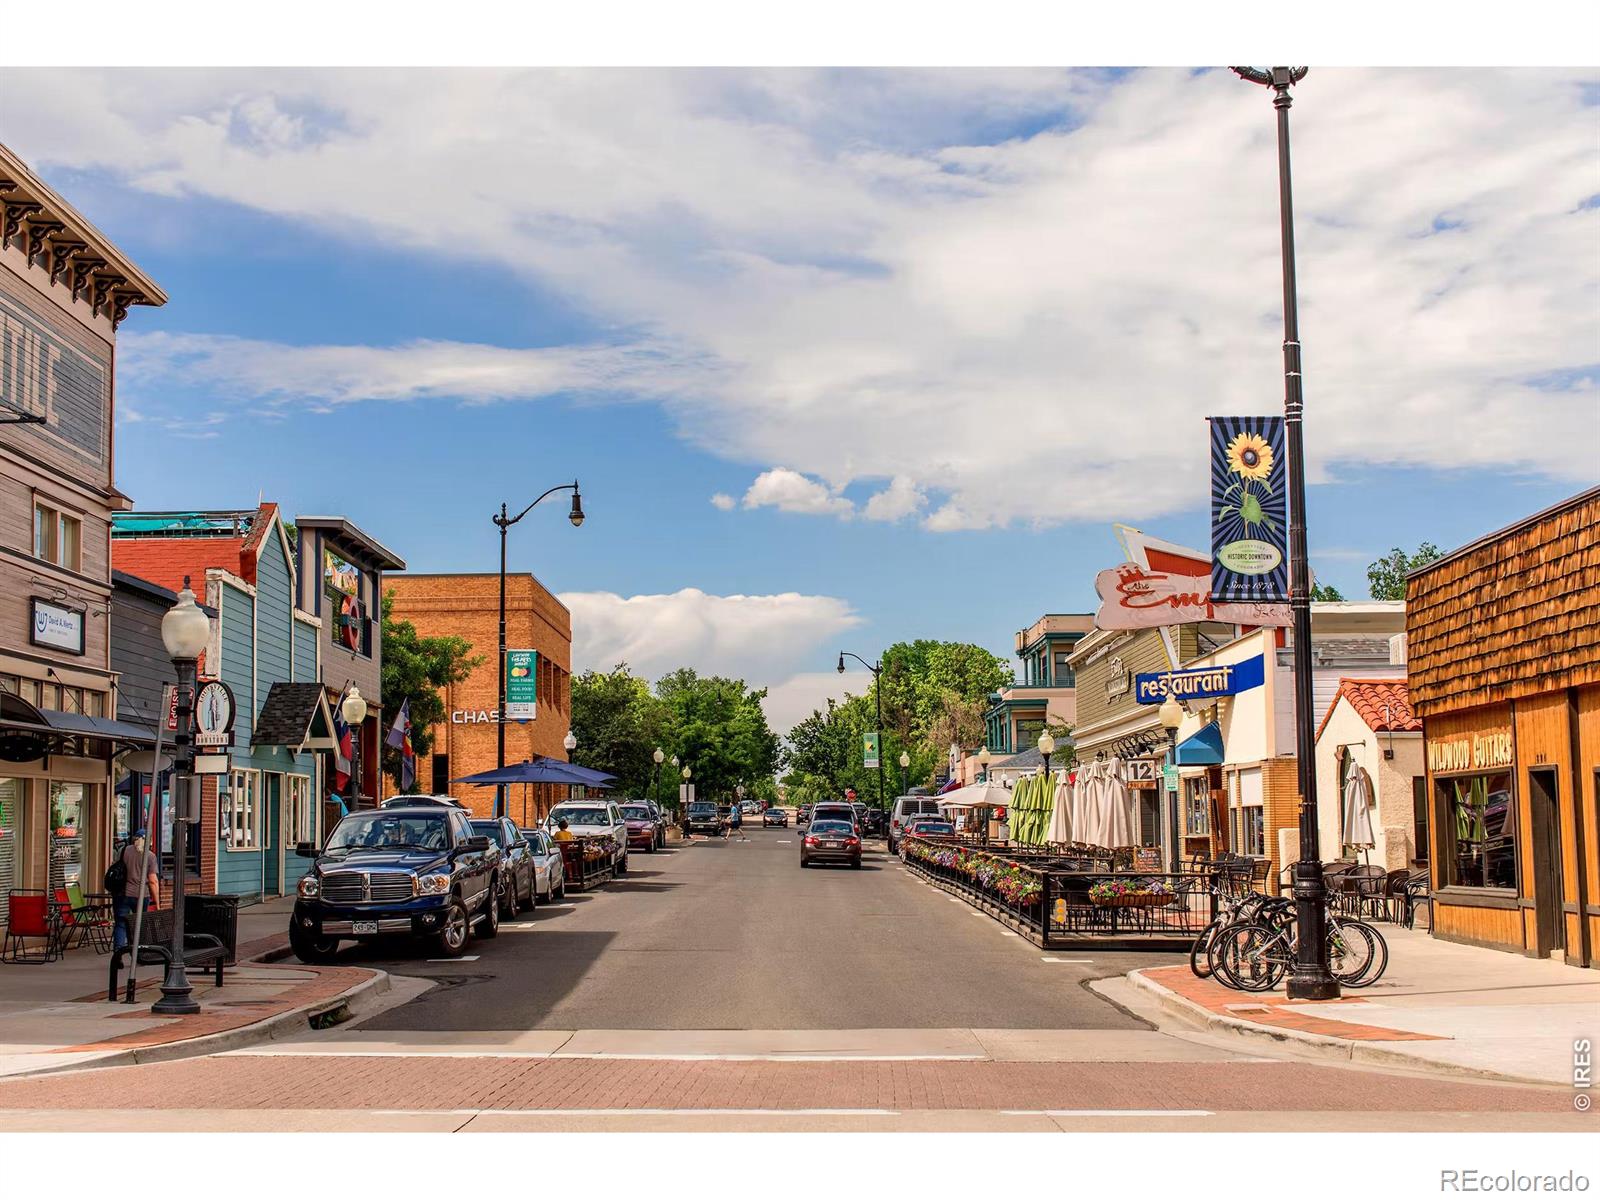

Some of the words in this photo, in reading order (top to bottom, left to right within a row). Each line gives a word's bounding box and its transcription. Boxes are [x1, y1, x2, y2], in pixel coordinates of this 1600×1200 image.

[0, 309, 61, 428] TILE
[1226, 580, 1251, 590] Since
[1252, 581, 1275, 591] 1878
[1140, 666, 1233, 697] restaurant
[452, 710, 512, 724] CHAS
[1427, 739, 1470, 772] WILDWOOD
[1473, 731, 1513, 768] GUITARS
